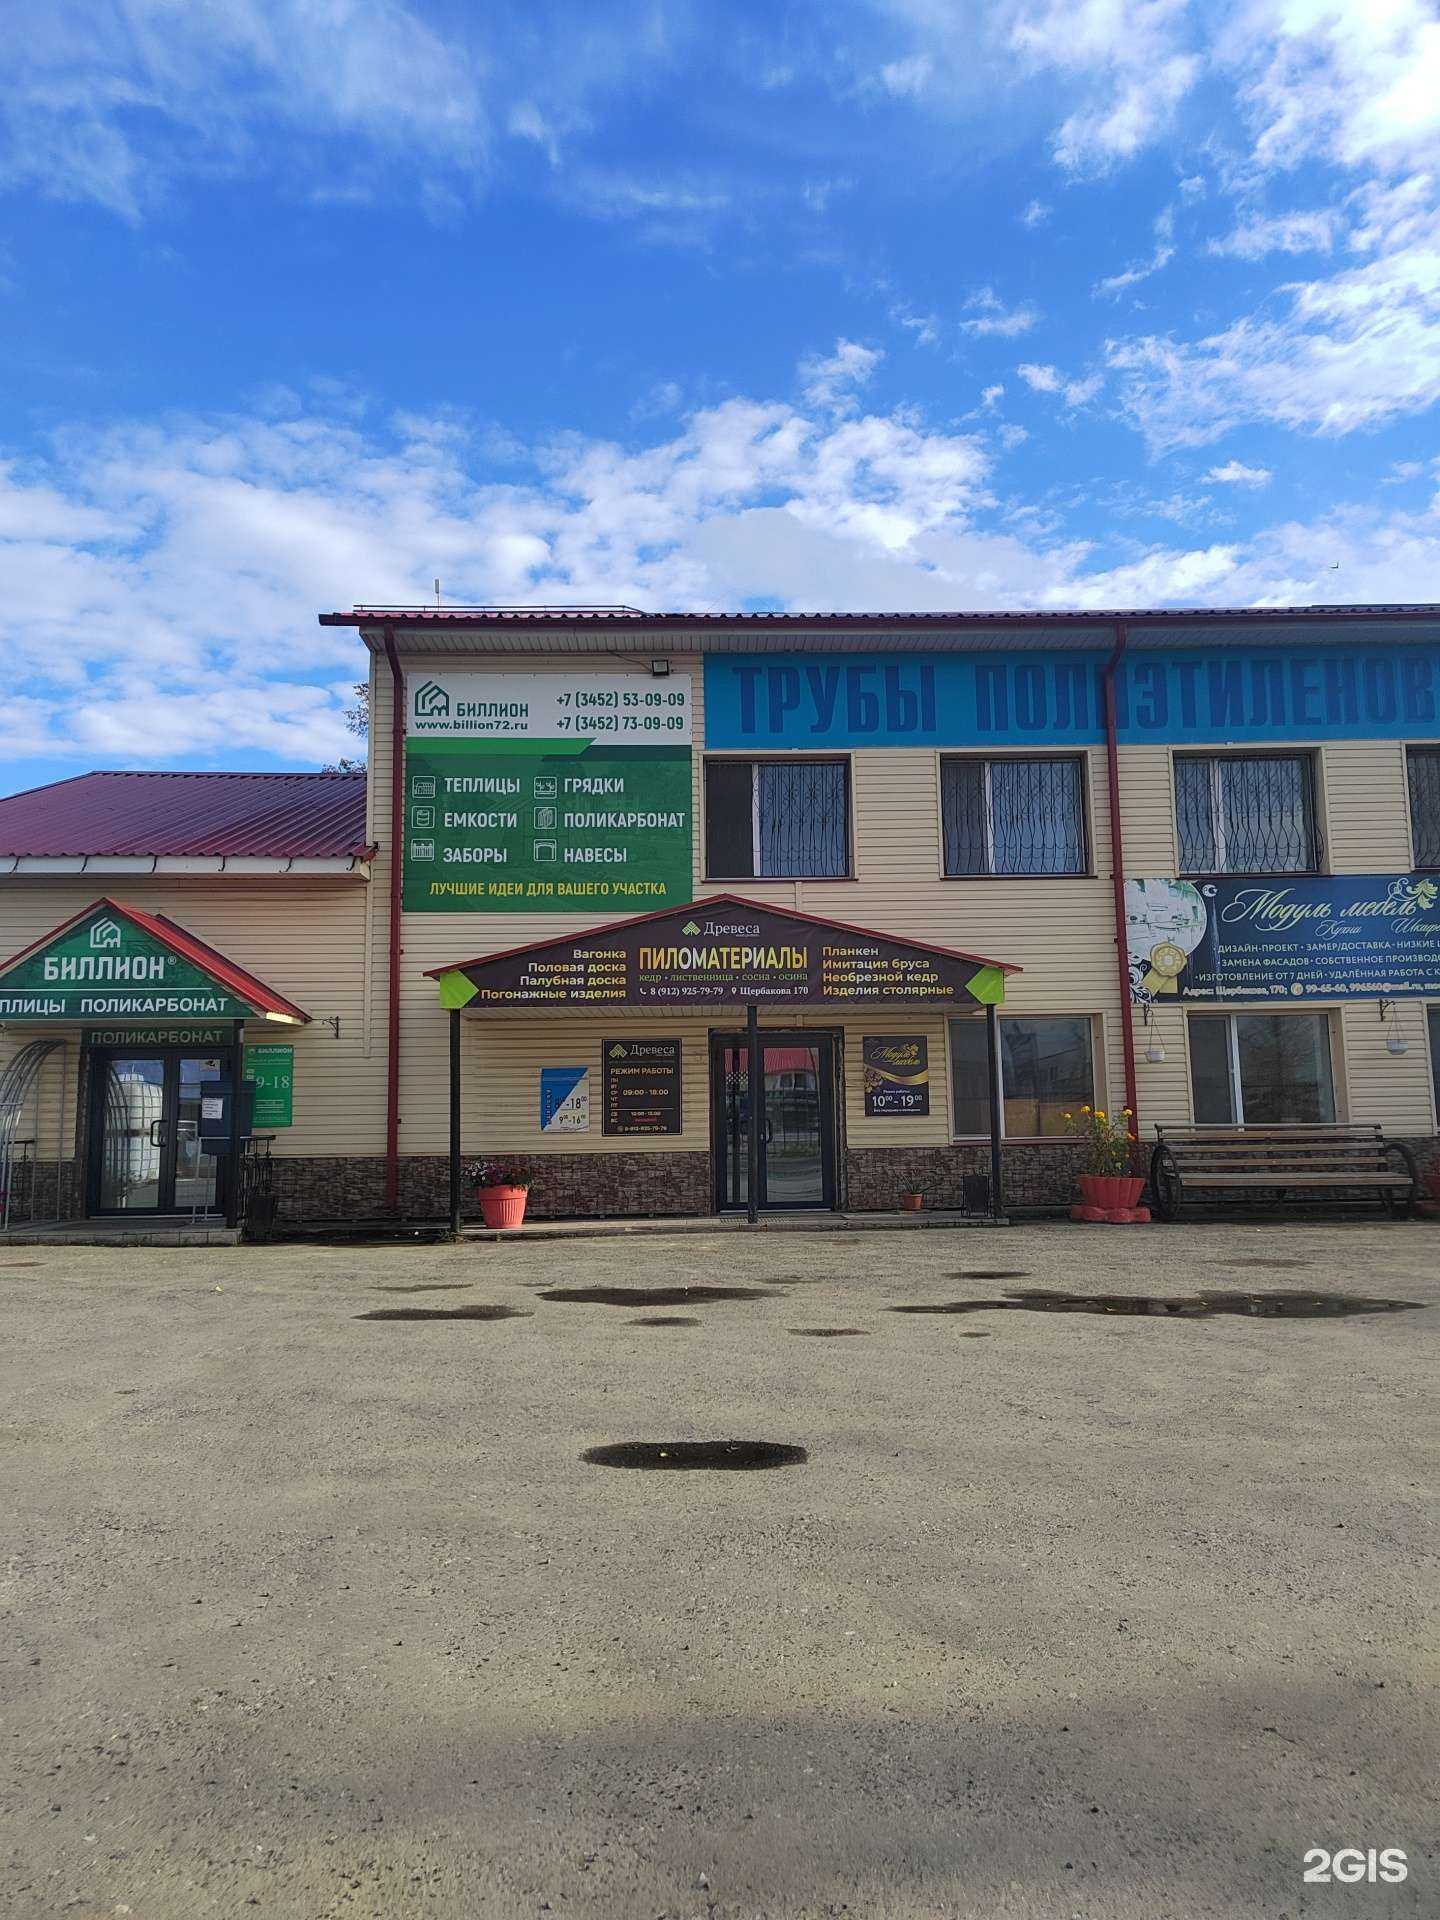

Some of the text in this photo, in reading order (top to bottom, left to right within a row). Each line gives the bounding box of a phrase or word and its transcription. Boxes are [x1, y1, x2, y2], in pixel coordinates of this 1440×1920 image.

[556, 691, 685, 708] +7 (3452) 53-09-09
[732, 664, 936, 734] ТРУБЫ
[456, 702, 529, 718] БИЛЛИОН
[415, 720, 528, 730] www.billion72.ru
[556, 714, 684, 732] +7 (3452) 73-09-09
[444, 777, 520, 795] ТЕПЛИЦЫ
[563, 778, 624, 795] ГРЯДКИ
[444, 812, 518, 828] ЕМКОСТИ
[563, 812, 685, 828] ПОЛИКАРБОНАТ
[443, 847, 507, 863] ЗАБОРЫ
[563, 847, 627, 863] НАВЕСЫ
[430, 882, 667, 897] ЛУЧШИЕ ИДЕИ ДЛЯ ВАШЕГО УЧАСТКА
[1221, 888, 1332, 931] Модуль
[703, 921, 760, 937] Древеса
[573, 949, 627, 959] Вагонка
[822, 946, 879, 956] Планкен
[1217, 943, 1298, 954] ДИЗАЙН-ПРОЕКТ
[1306, 941, 1391, 952] ЗАМЕР/ДОСТАВКА
[1396, 940, 1435, 949] НИЗКИЕ
[639, 946, 808, 970] ПИЛОМАТЕРИАЛЫ
[822, 958, 930, 971] Имитация бруса
[1222, 958, 1262, 967] ЗАМЕНА
[1262, 957, 1309, 967] ФАСАДОВ
[1315, 956, 1384, 965] СОБСТВЕННОЕ
[44, 956, 165, 980] БИЛЛИОН
[528, 962, 627, 973] Половая доска
[519, 975, 627, 988] Палубная доска
[639, 972, 808, 984] кедр лиственница сосна осина
[823, 971, 939, 984] Необрезной кедр
[1200, 971, 1275, 982] ИЗГОТОВЛЕНИЕ
[1275, 972, 1288, 980] ОТ
[1290, 972, 1295, 980] 7
[1296, 970, 1323, 981] ДНЕЙ
[1388, 969, 1425, 977] РАБОТА
[481, 989, 627, 1000] Погонажные изделия
[657, 987, 680, 997] (912)
[682, 987, 724, 996] 925-79-79
[740, 987, 791, 997] Щербакова
[794, 986, 809, 995] 170
[823, 985, 954, 997] Изделия столярные
[80, 997, 228, 1012] ПОЛИКАРБОНАТ
[91, 1030, 223, 1044] ПОЛИКАРБОНАТ
[630, 1044, 675, 1057] Древеса
[610, 1067, 674, 1075] РЕЖИМ РАБОТЫ
